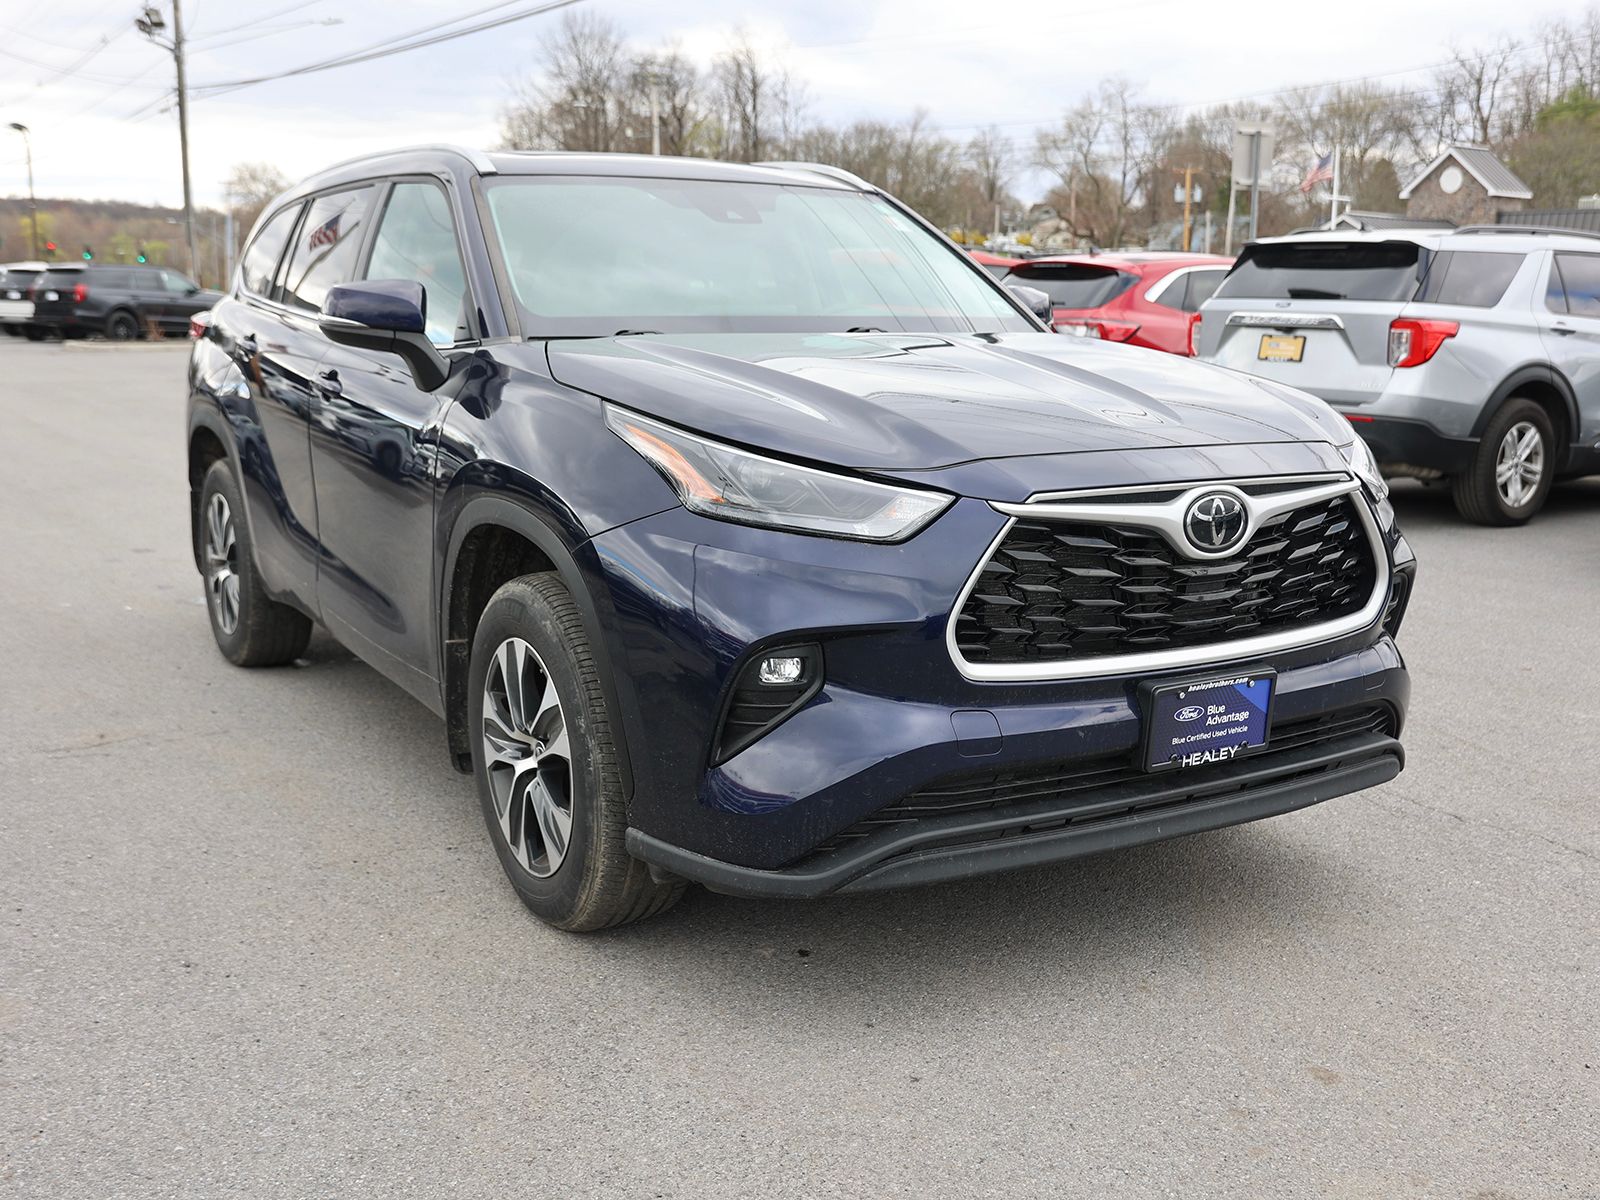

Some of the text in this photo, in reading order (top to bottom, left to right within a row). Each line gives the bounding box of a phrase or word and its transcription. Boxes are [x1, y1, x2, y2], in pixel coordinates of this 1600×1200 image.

[1188, 677, 1249, 692] healeybrothers.com
[1178, 708, 1201, 721] Ford
[1207, 704, 1226, 715] Blue
[1205, 711, 1249, 726] Advantage
[1171, 725, 1248, 745] Blue Certified Used Vehicle
[1181, 745, 1238, 768] HEALEY
